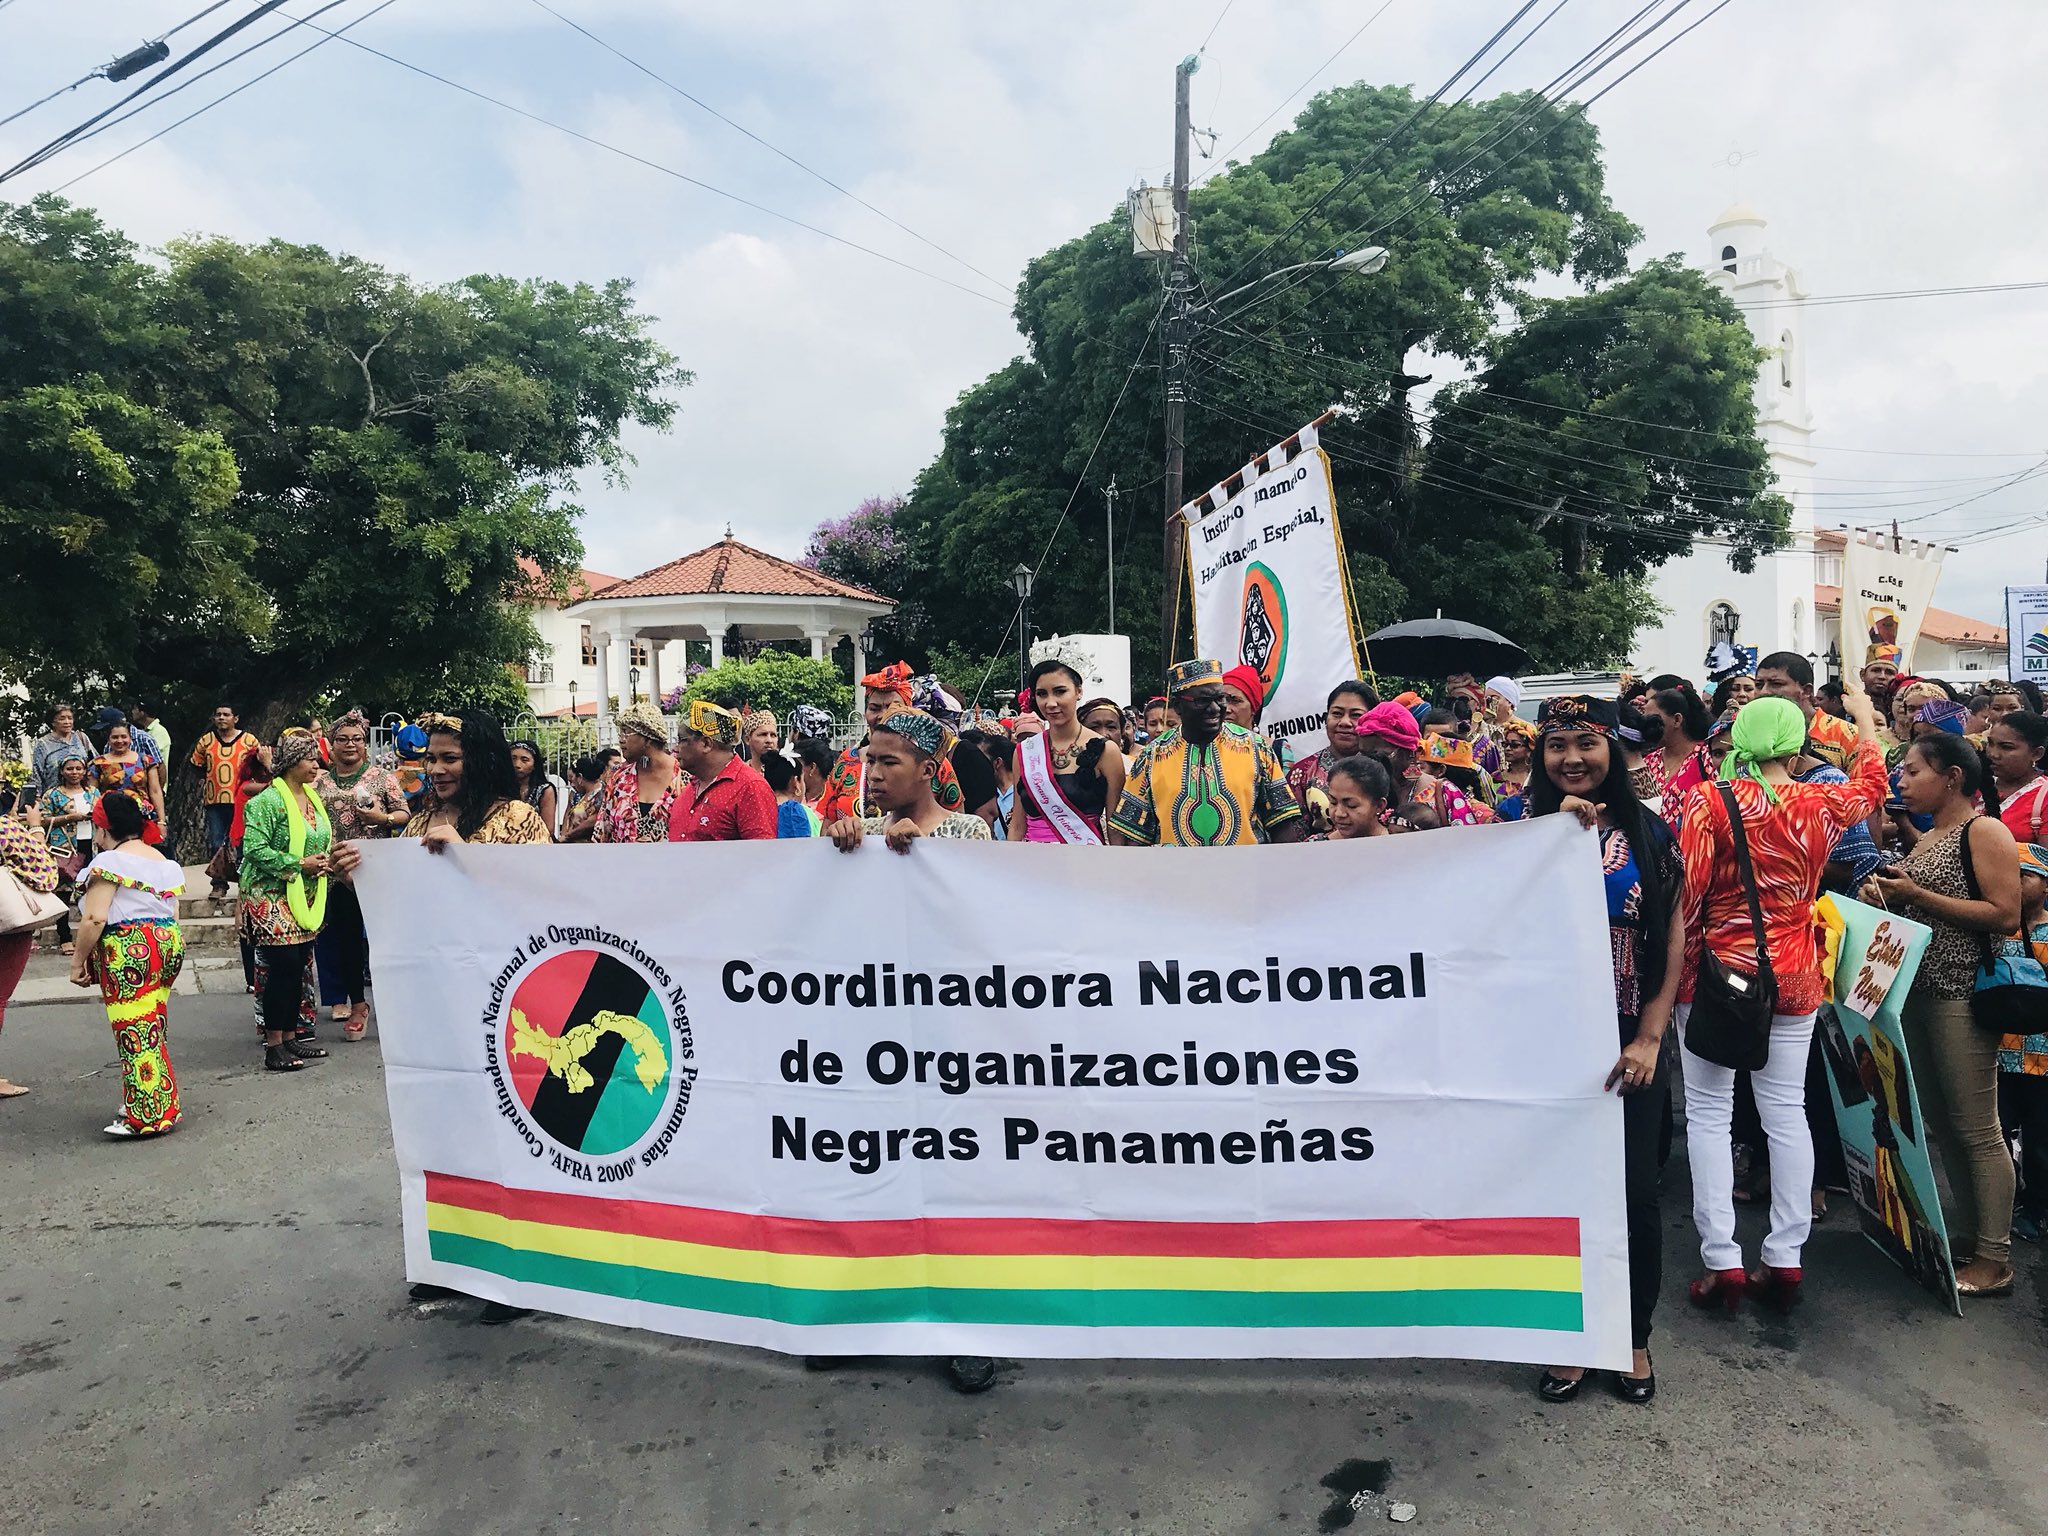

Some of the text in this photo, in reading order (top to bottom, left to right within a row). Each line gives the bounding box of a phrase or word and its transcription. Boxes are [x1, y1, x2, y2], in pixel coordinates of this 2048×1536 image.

[1262, 505, 1325, 544] Especial,
[1268, 711, 1328, 740] PENONOM
[722, 953, 1426, 1008] Coordinadora Nacional
[482, 924, 699, 1168] Coordinadora Nacional de Organizaciones Negras Panameñas
[780, 1039, 1359, 1095] de Organizaciones
[772, 1115, 1374, 1175] Negras Panameñas
